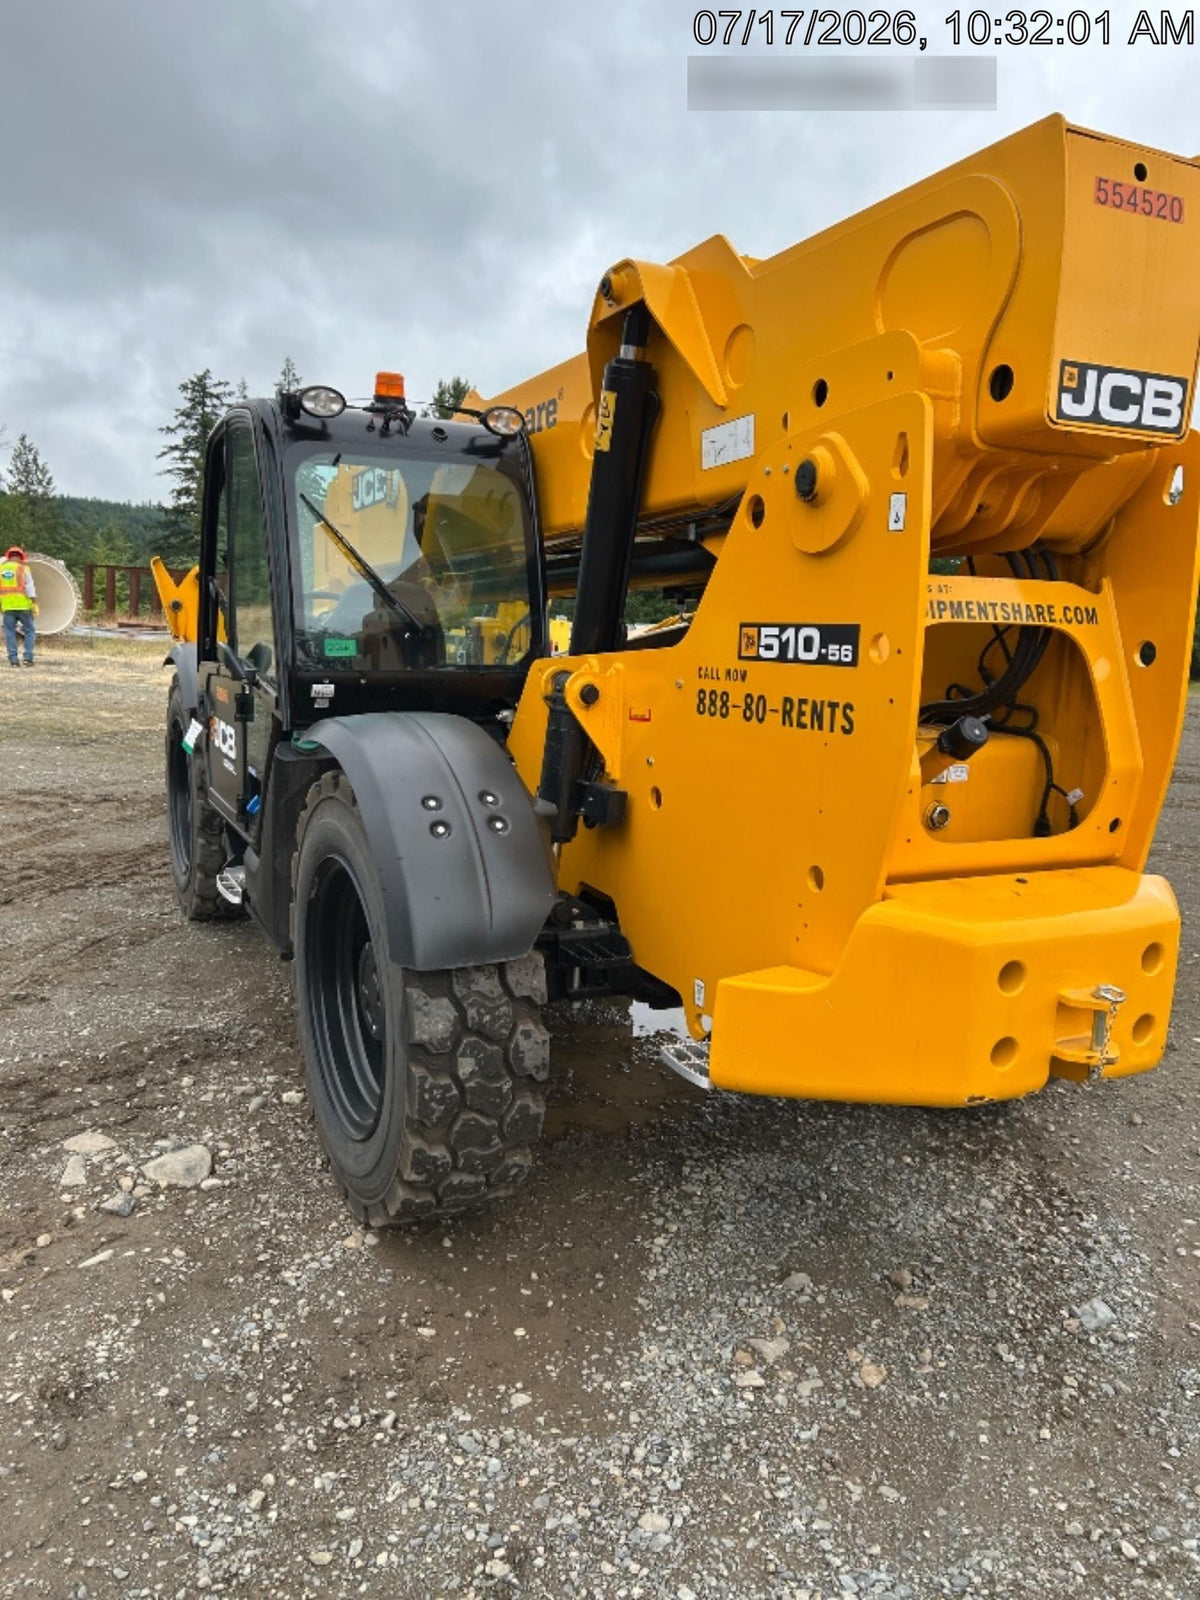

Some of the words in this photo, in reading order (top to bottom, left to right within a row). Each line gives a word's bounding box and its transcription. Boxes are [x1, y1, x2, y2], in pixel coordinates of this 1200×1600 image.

[1096, 177, 1183, 223] 554520
[524, 397, 558, 435] are
[1060, 368, 1184, 429] JCB
[926, 599, 1099, 625] IPMENTSHARE.COM
[697, 666, 721, 681] CALL
[724, 667, 748, 683] NOW
[696, 687, 855, 735] 888-80-RENTS
